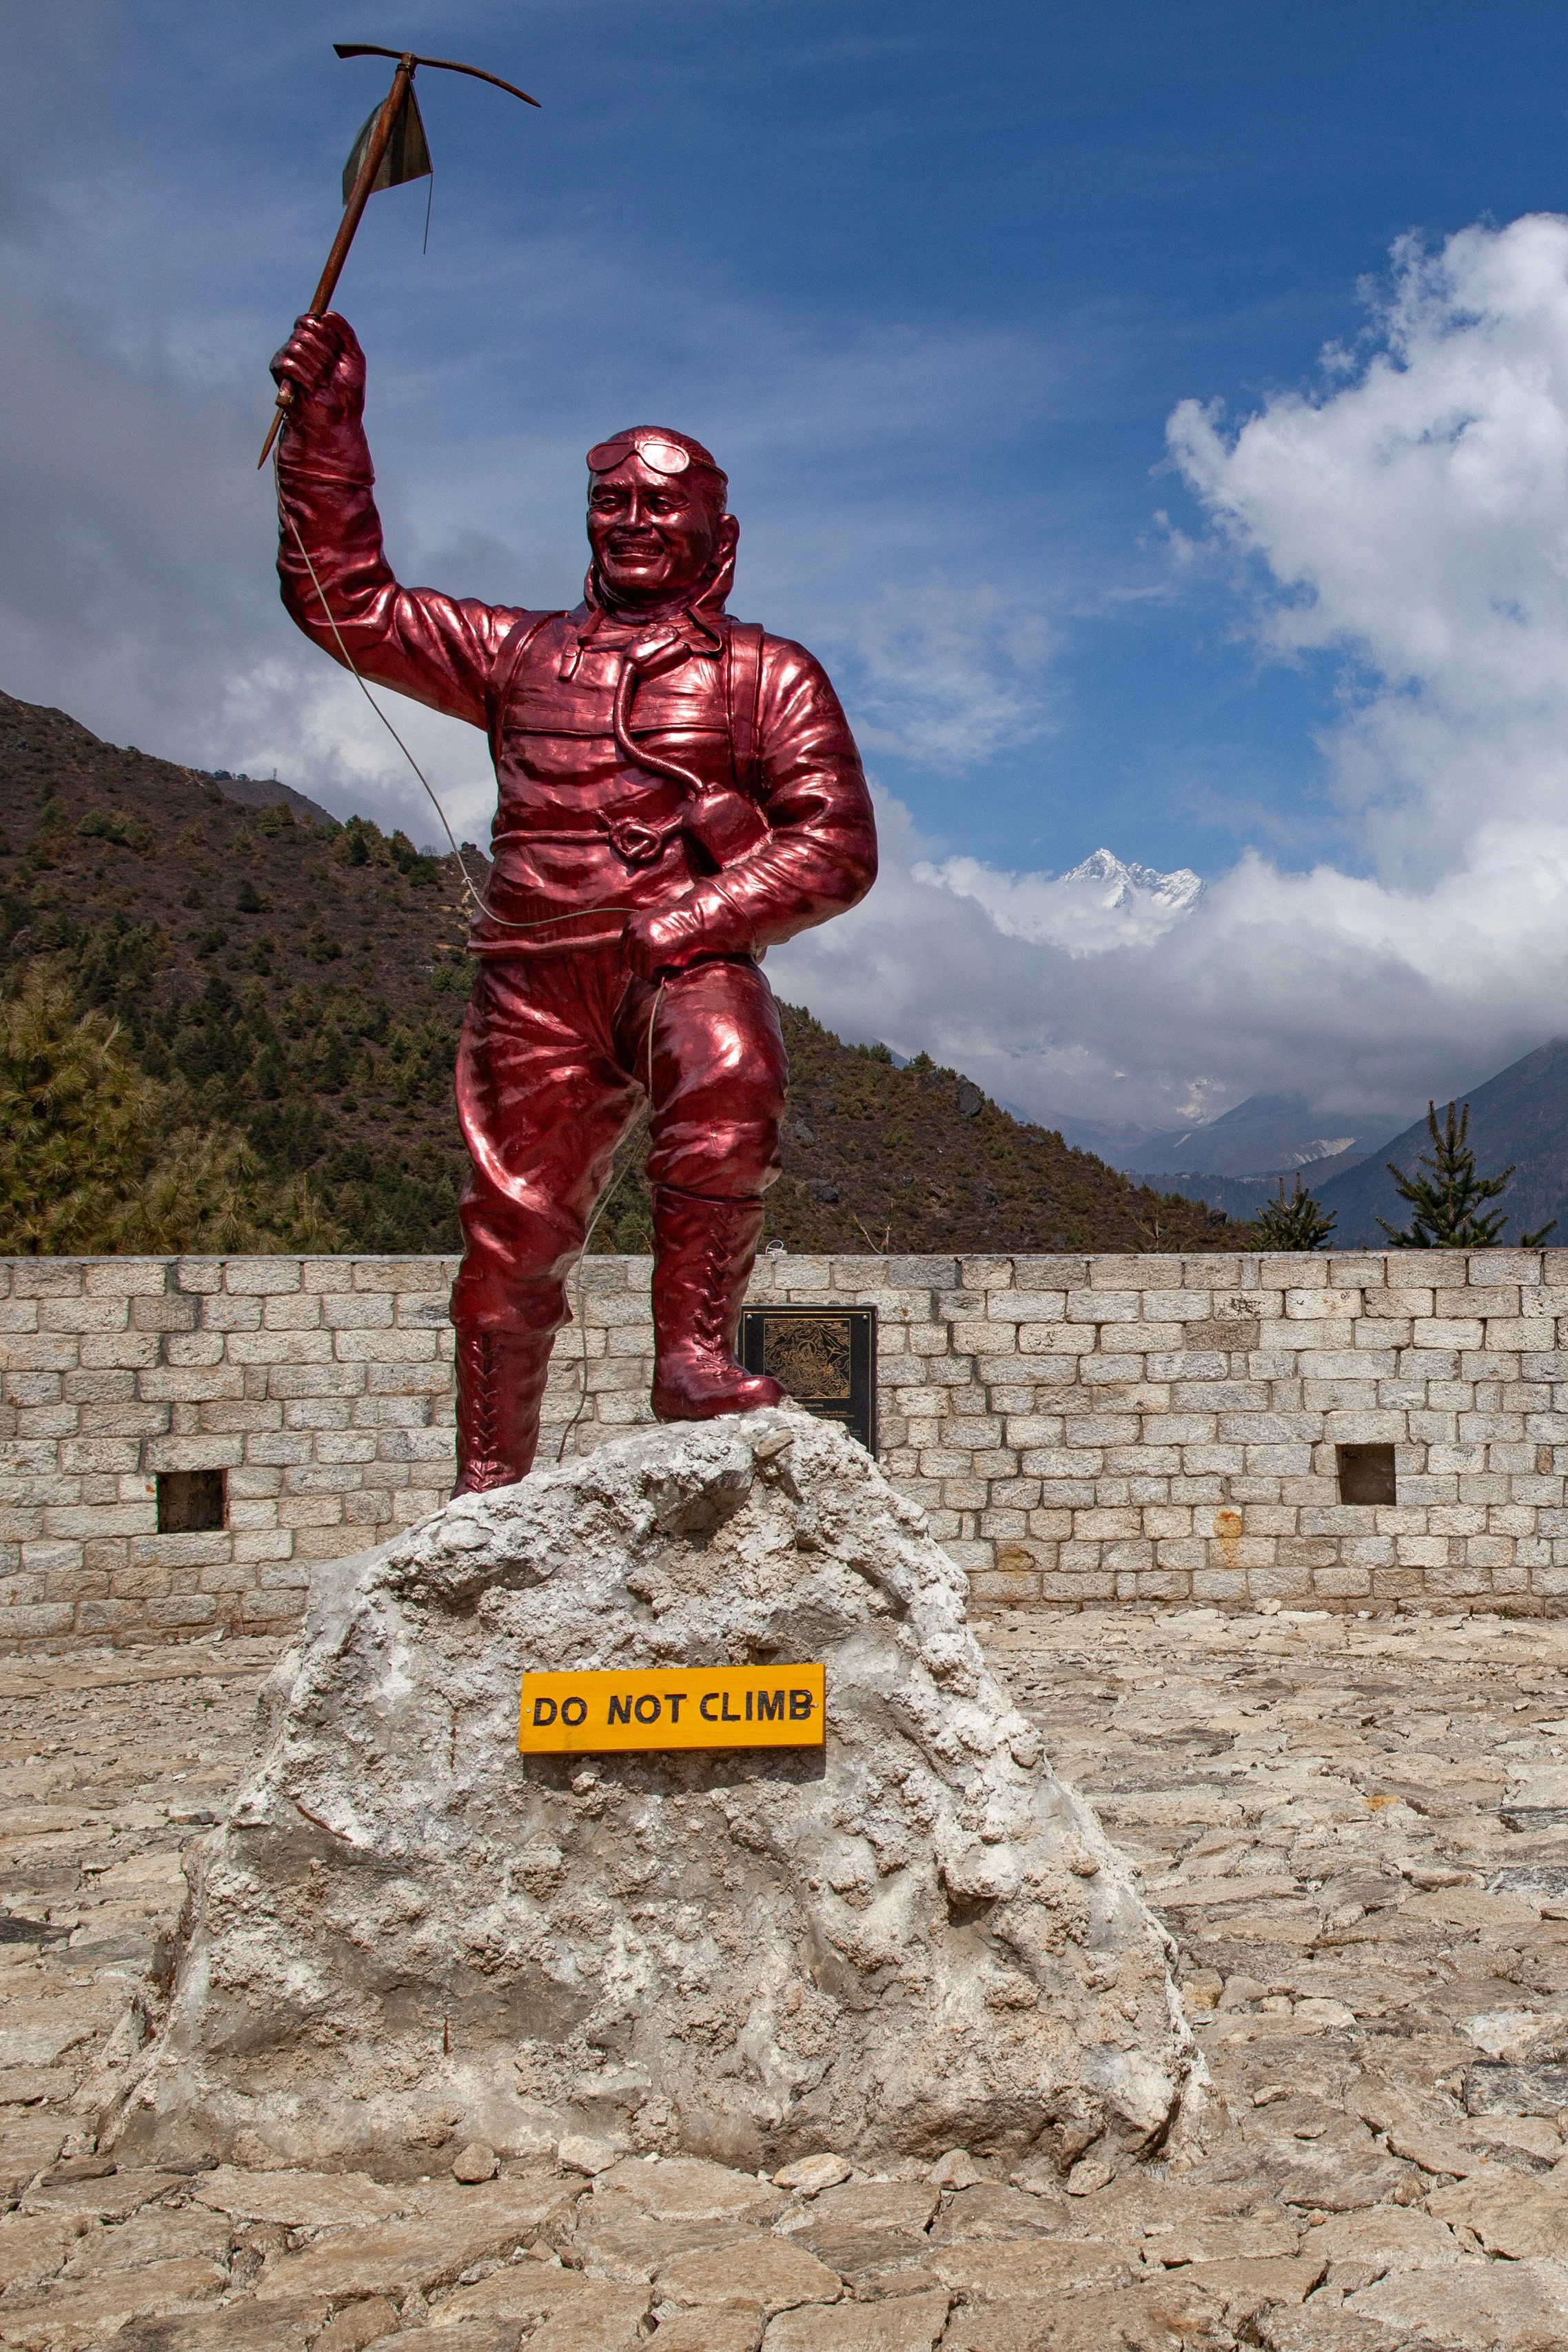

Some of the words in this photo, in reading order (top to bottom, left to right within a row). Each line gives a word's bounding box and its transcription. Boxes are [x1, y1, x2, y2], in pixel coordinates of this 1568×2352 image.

[533, 1697, 587, 1726] DO
[608, 1694, 687, 1725] NOT
[700, 1690, 813, 1722] CLIMB
